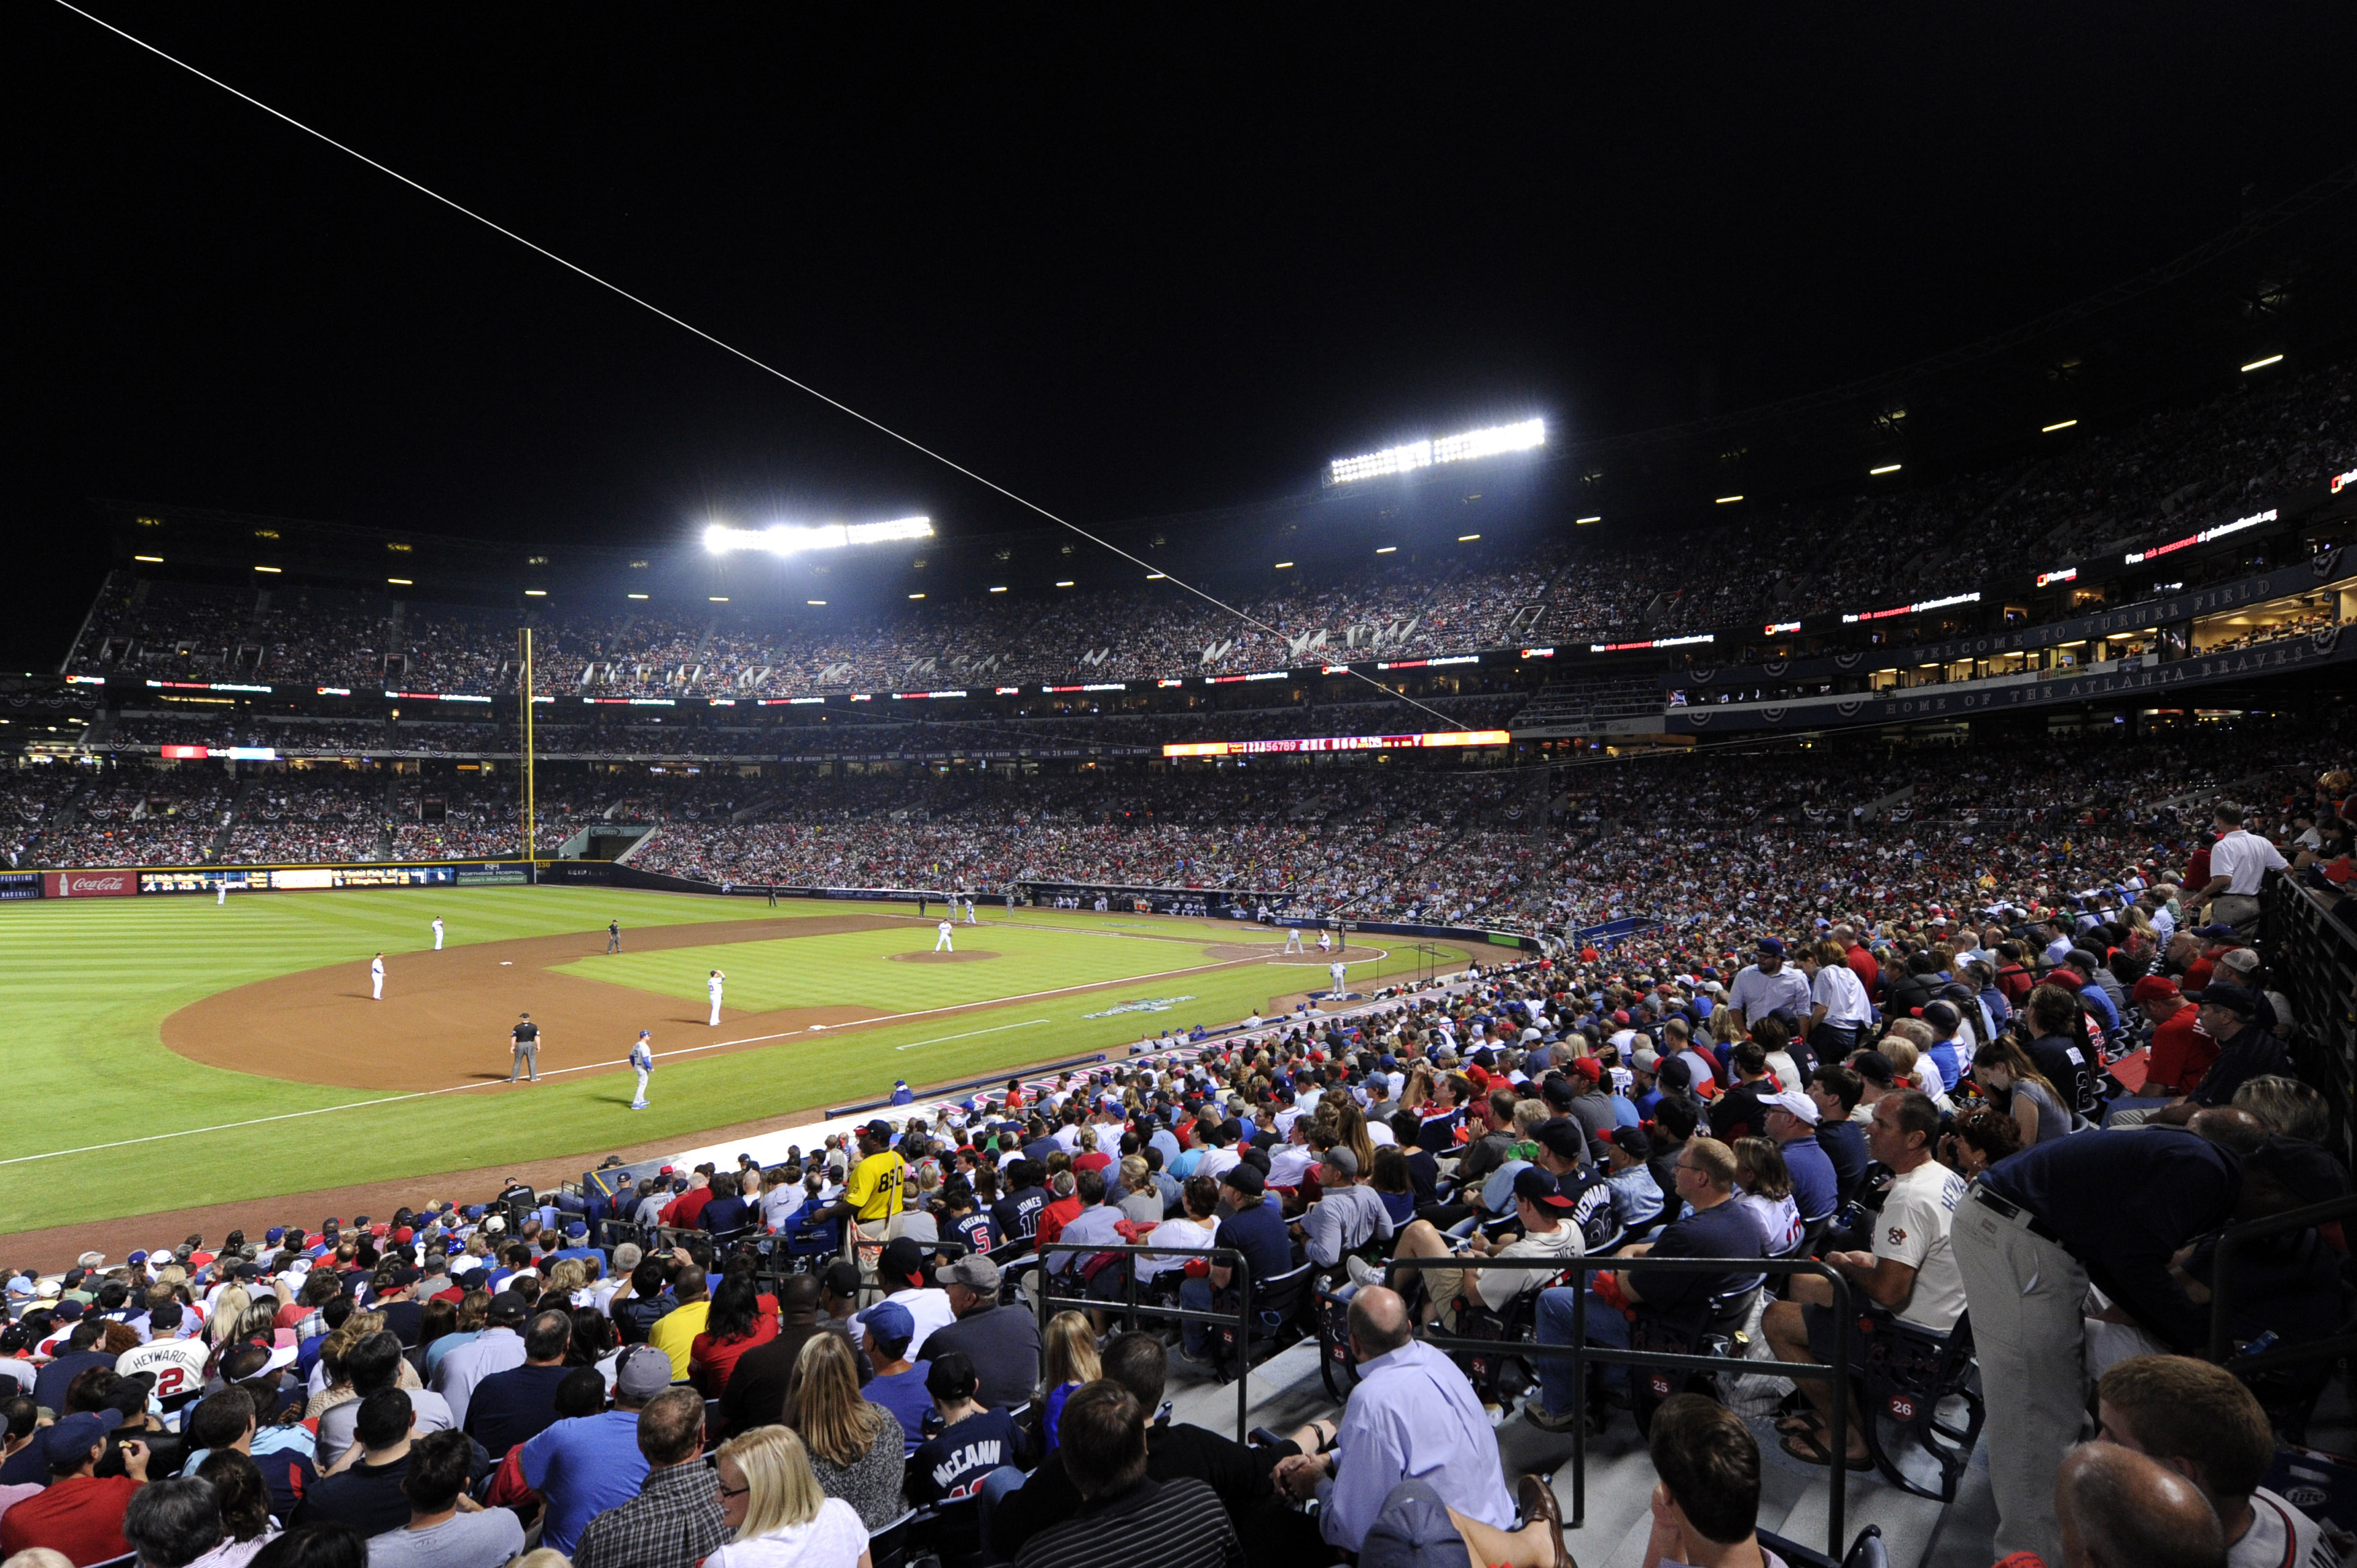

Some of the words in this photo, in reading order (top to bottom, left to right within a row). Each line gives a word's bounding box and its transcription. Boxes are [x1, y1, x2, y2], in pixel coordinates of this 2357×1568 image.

[2145, 548, 2157, 559] risk
[2159, 534, 2196, 554] assessment
[2198, 531, 2206, 542] at
[1873, 606, 1910, 618] assessment
[1913, 634, 2023, 661] WELCOME
[2040, 627, 2065, 641] TO
[2084, 604, 2179, 633] TURNER
[2194, 580, 2270, 611] FIELD
[1617, 641, 1652, 649] assessment
[1886, 698, 1946, 714] HOME
[1964, 694, 1991, 706] OF
[2010, 687, 2052, 702] THE
[2070, 668, 2184, 695] ATLANTA
[2202, 647, 2303, 677] BRAVES
[1546, 726, 1587, 734] GEORGIA'S
[72, 876, 125, 891] Coca-Cola
[878, 1165, 904, 1194] 860
[1017, 1196, 1042, 1216] JONES
[1572, 1184, 1611, 1226] HEYWARD
[957, 1213, 990, 1235] FREEMAN
[971, 1226, 991, 1255] 5
[1224, 1332, 1232, 1343] 22
[132, 1350, 187, 1370] HEYWARD
[1334, 1348, 1345, 1360] 23
[1474, 1362, 1485, 1374] 24
[1653, 1379, 1668, 1393] 25
[1892, 1400, 1912, 1416] 26
[932, 1440, 1001, 1489] McCANN
